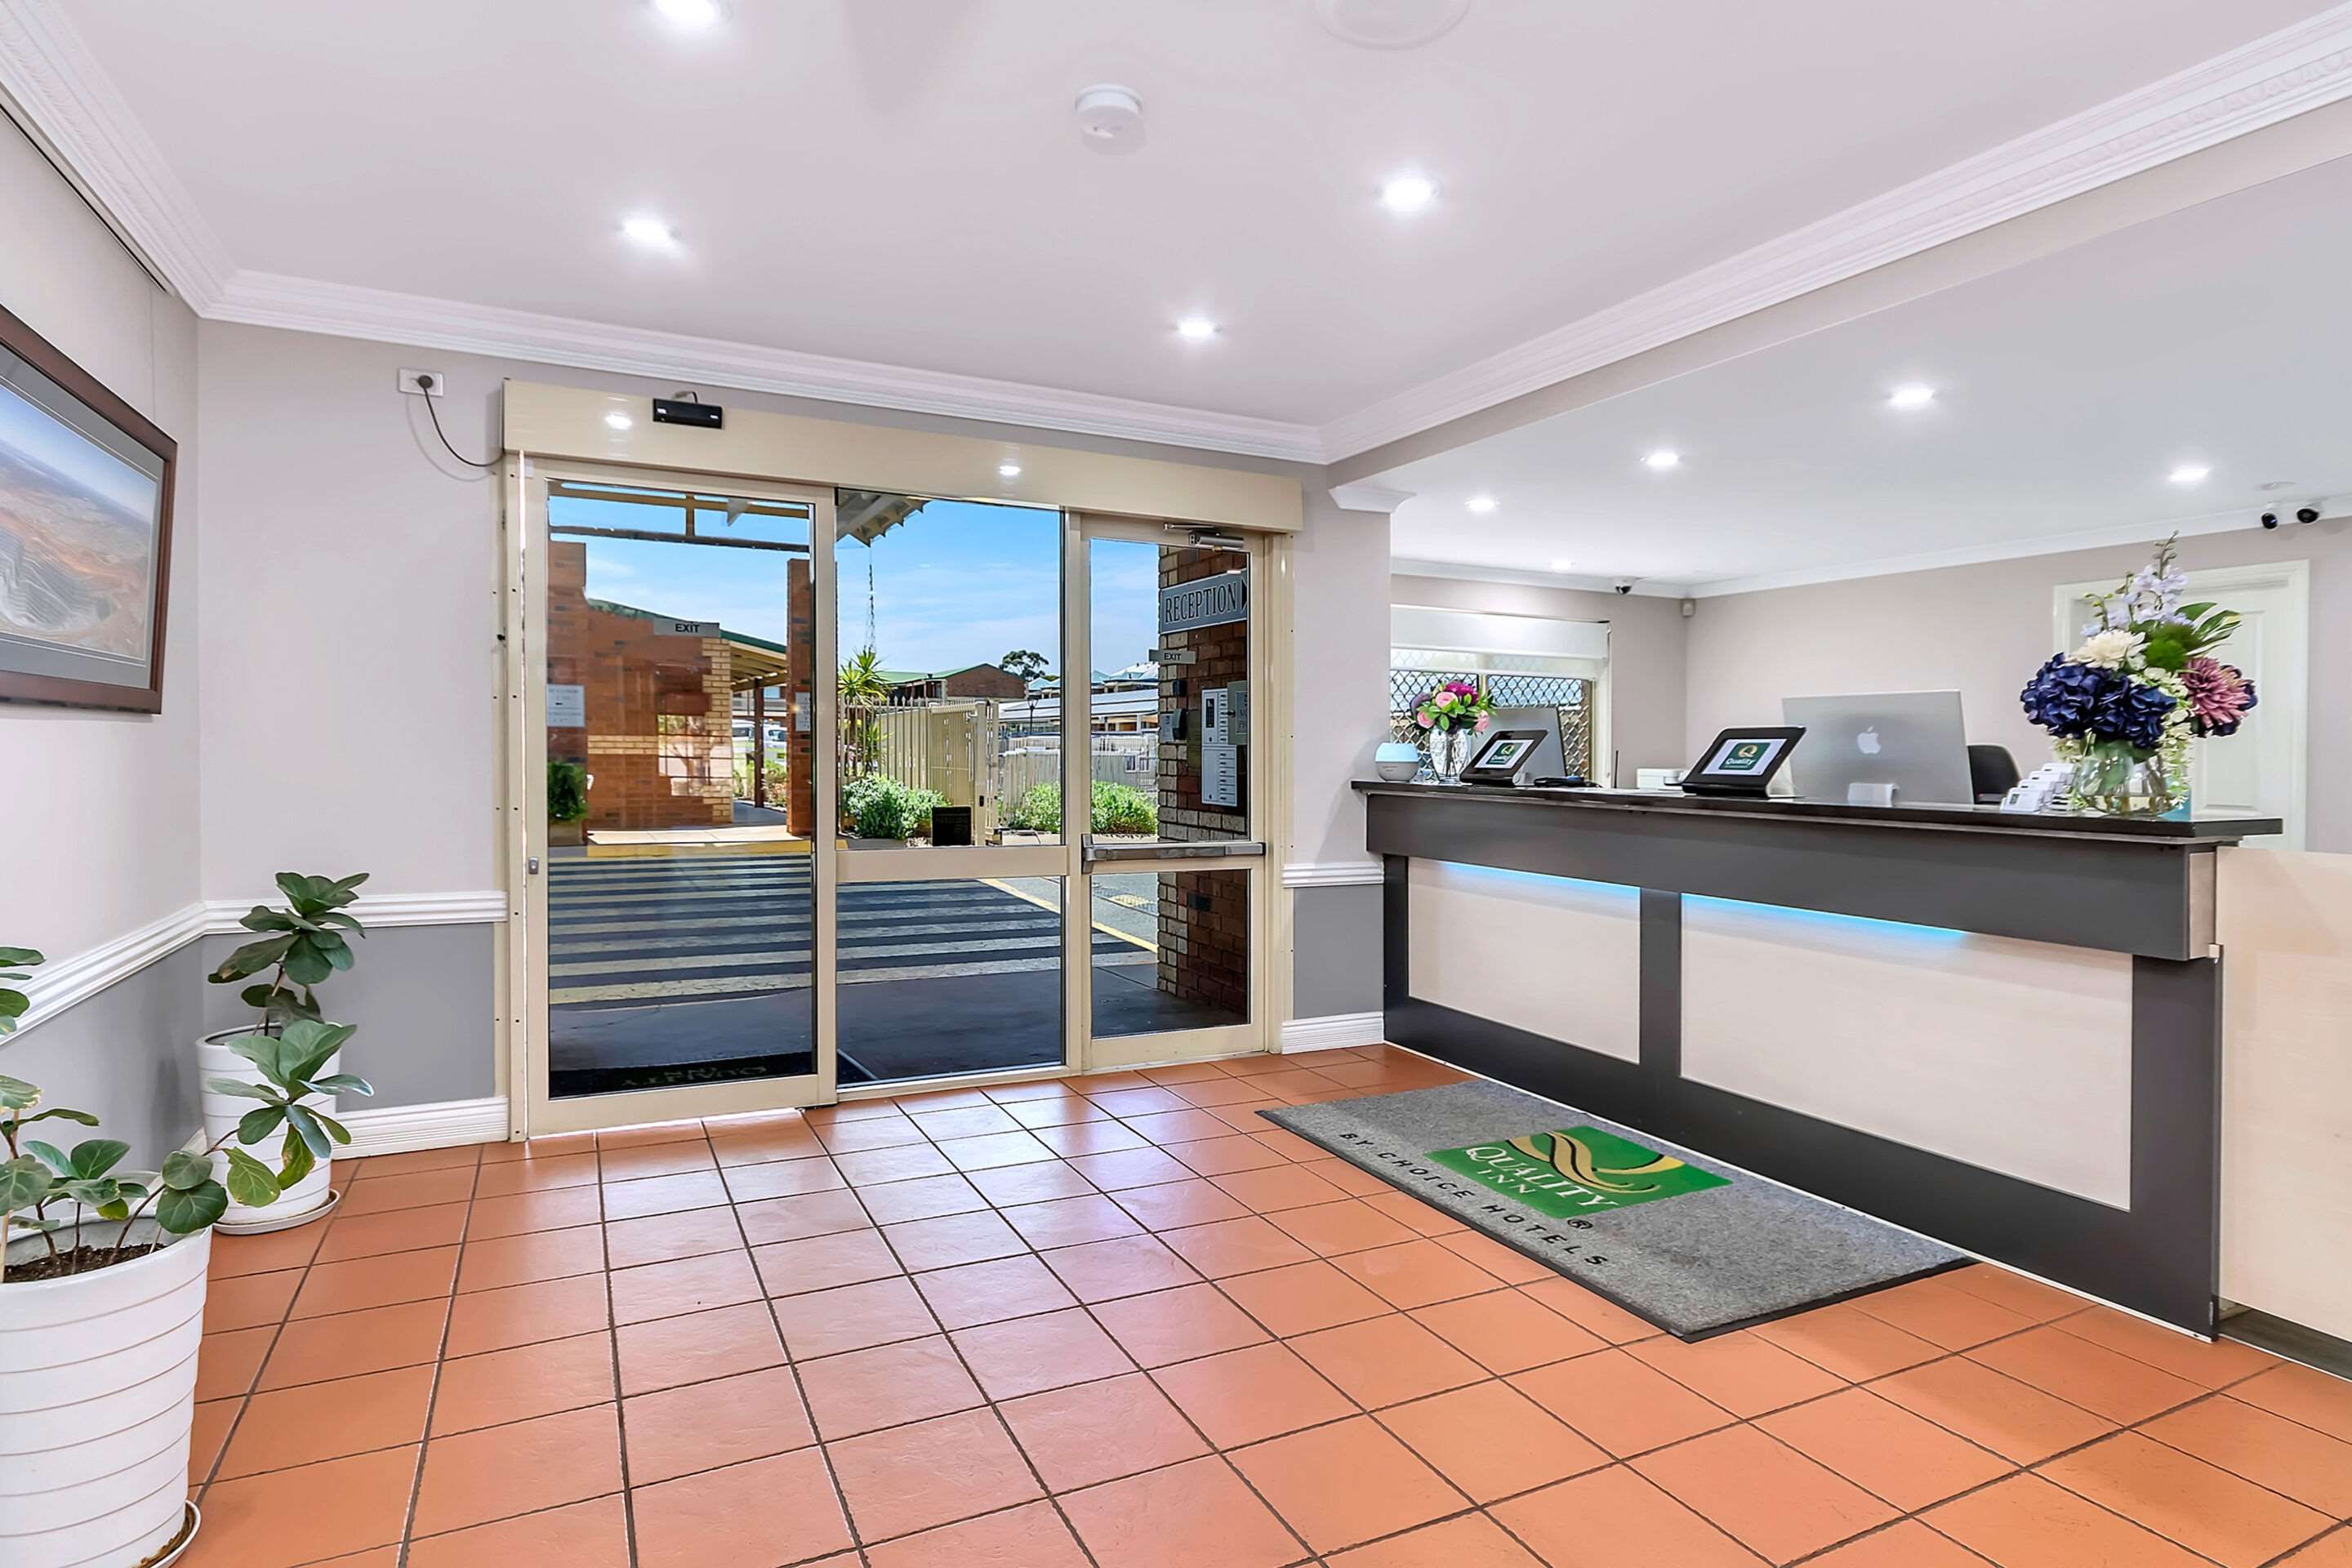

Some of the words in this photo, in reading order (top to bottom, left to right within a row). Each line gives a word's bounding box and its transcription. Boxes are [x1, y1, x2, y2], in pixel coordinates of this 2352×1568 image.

[1165, 581, 1238, 624] RECEPTION
[675, 622, 700, 634] EXIT
[1163, 653, 1183, 661] EXIT
[1726, 757, 1757, 766] Quality
[1463, 1146, 1620, 1207] QUALITY
[1476, 1168, 1537, 1195] INN
[1339, 1133, 1375, 1146] BY
[1378, 1152, 1476, 1199] CHOICE
[1481, 1204, 1609, 1266] HOTELS
